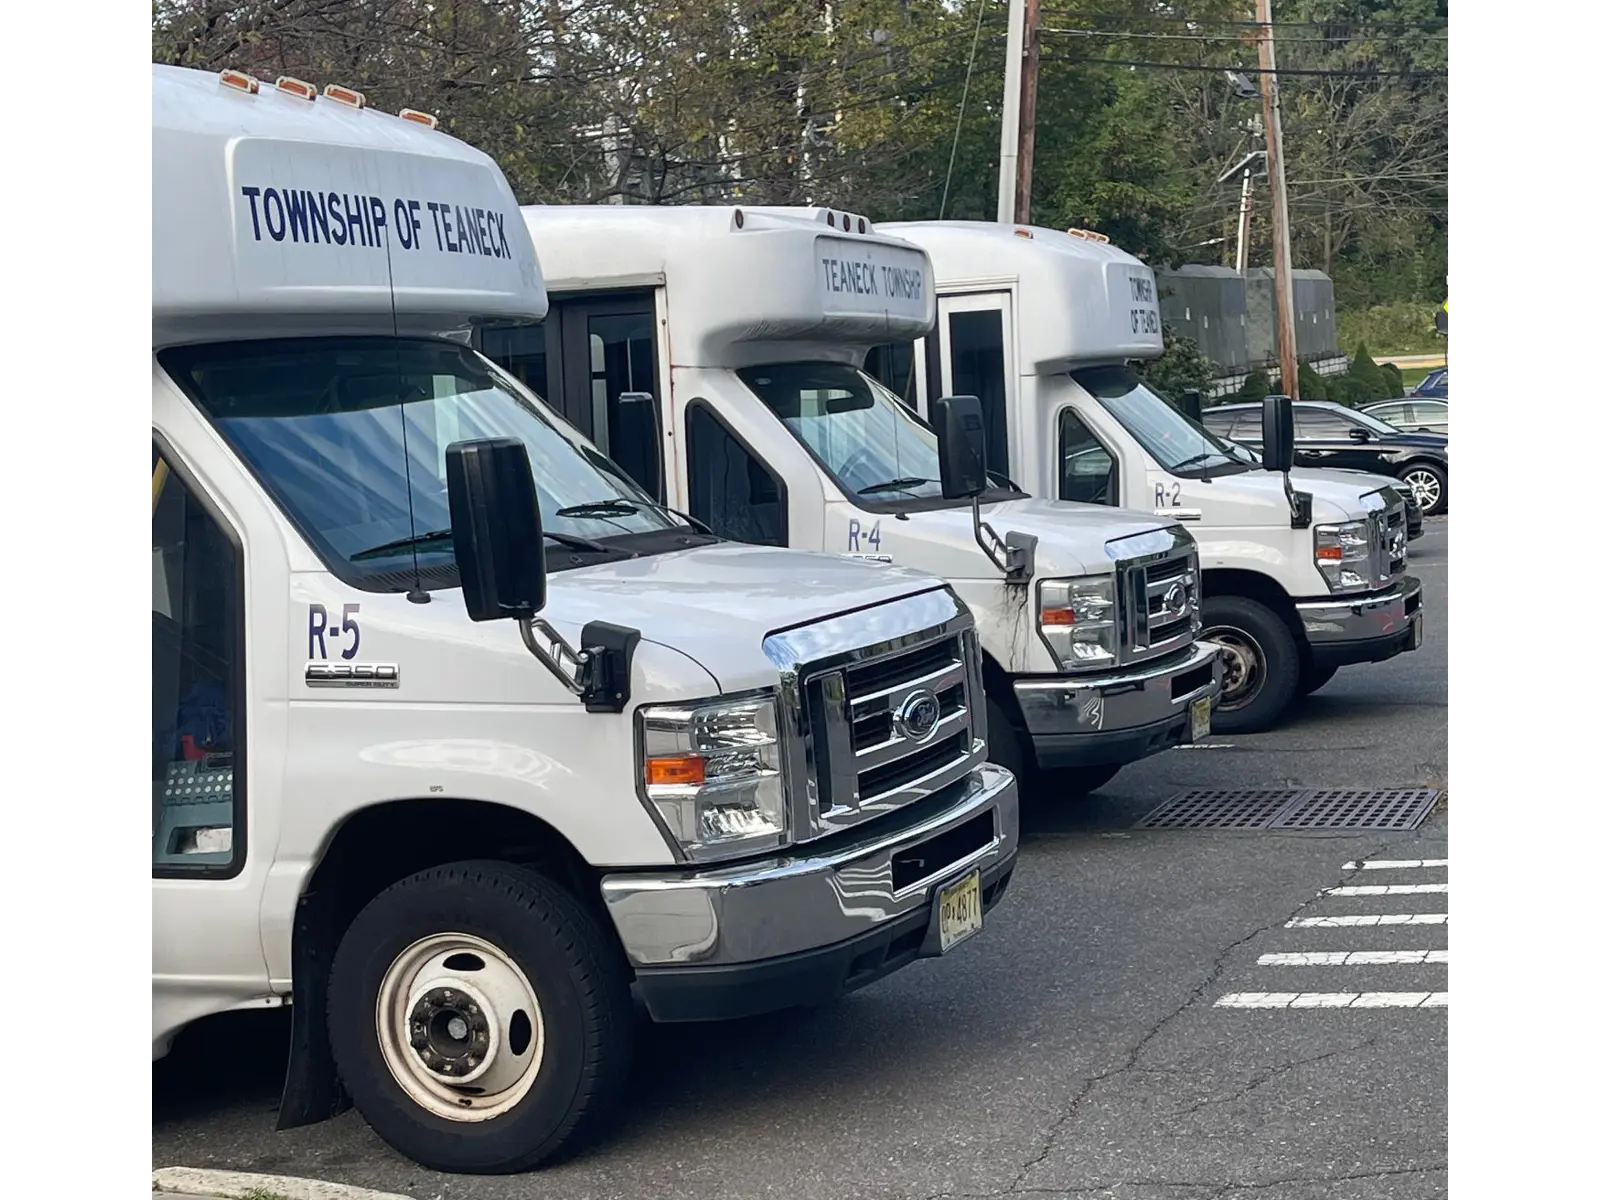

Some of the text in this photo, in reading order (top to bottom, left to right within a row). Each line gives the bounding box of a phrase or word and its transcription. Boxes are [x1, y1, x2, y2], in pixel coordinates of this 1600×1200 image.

[242, 186, 512, 259] TOWNSHIP OF TEANECK
[822, 258, 921, 300] TEANECK TOWNSHIP
[1130, 309, 1139, 334] OF
[1155, 482, 1181, 508] R-2
[848, 518, 881, 552] R-4
[309, 603, 361, 660] R-5
